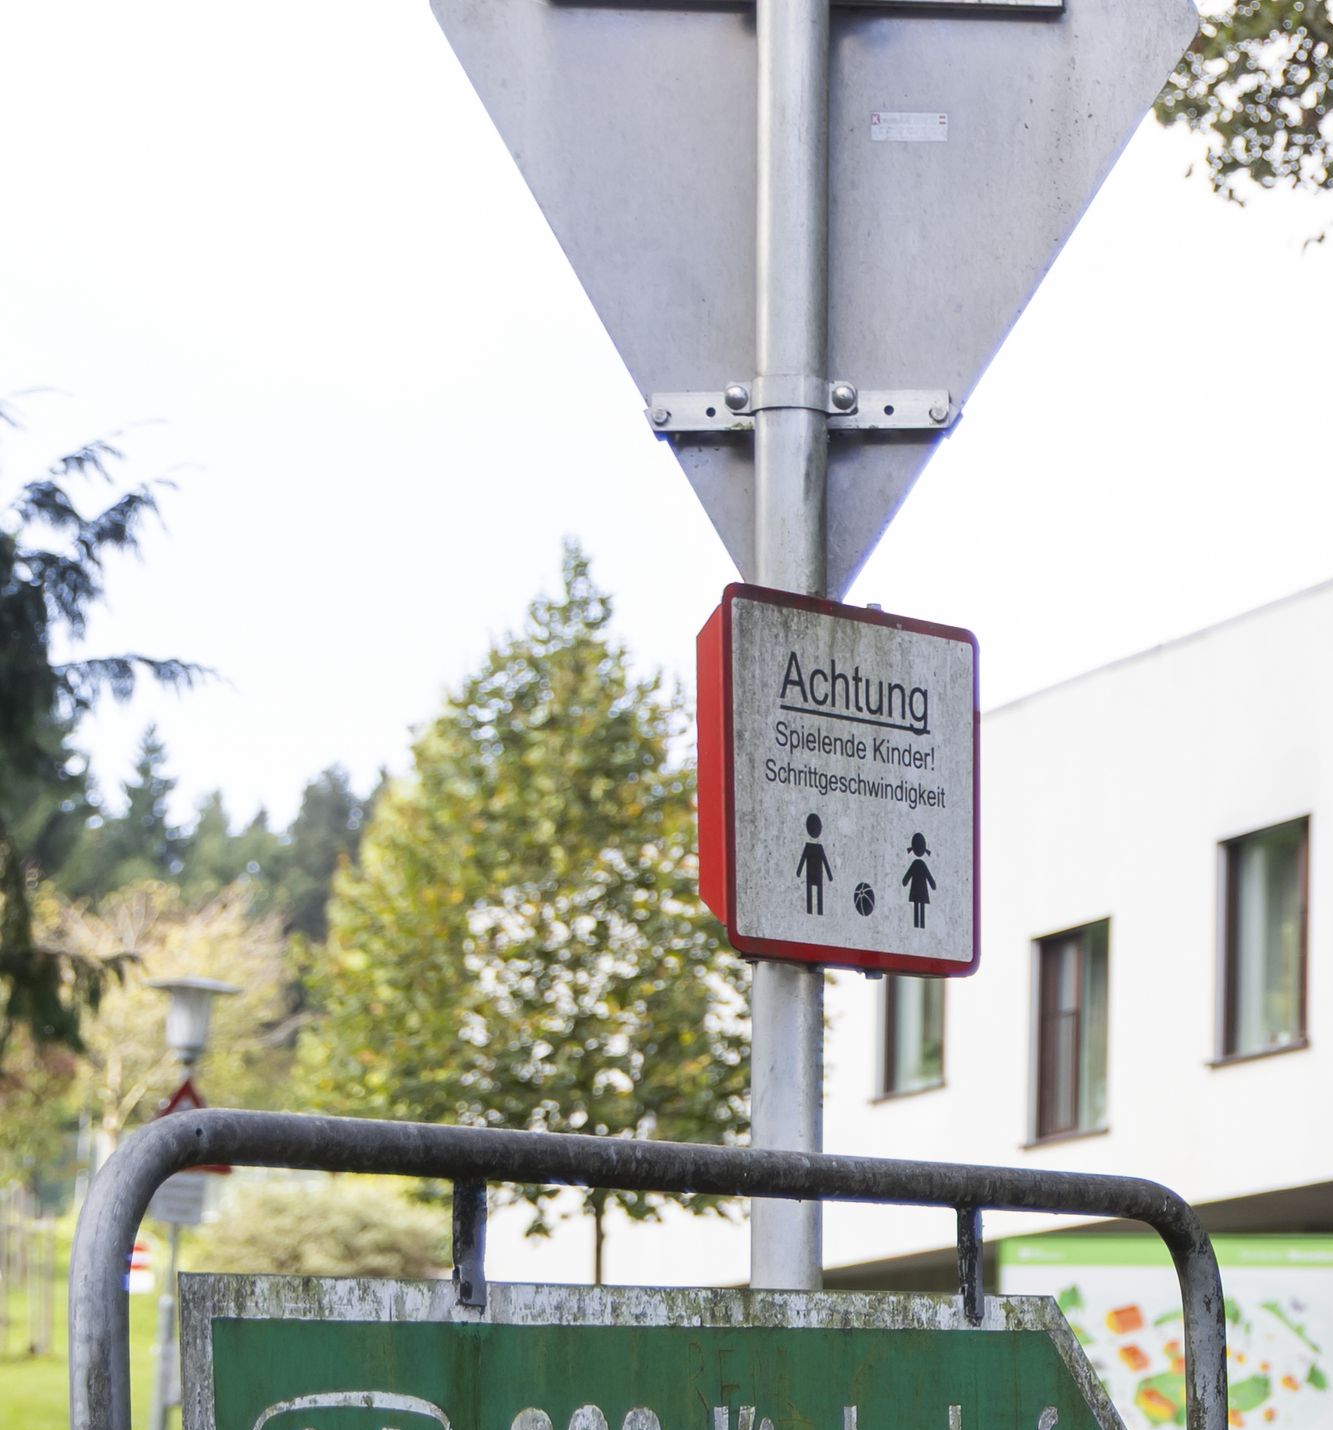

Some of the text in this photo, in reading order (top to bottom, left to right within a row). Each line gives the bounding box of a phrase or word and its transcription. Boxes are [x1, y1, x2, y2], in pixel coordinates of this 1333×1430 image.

[779, 651, 930, 736] Achtung
[775, 721, 936, 771] Spielende Kinder!
[765, 758, 946, 810] Schrittgeschwindigkeit
